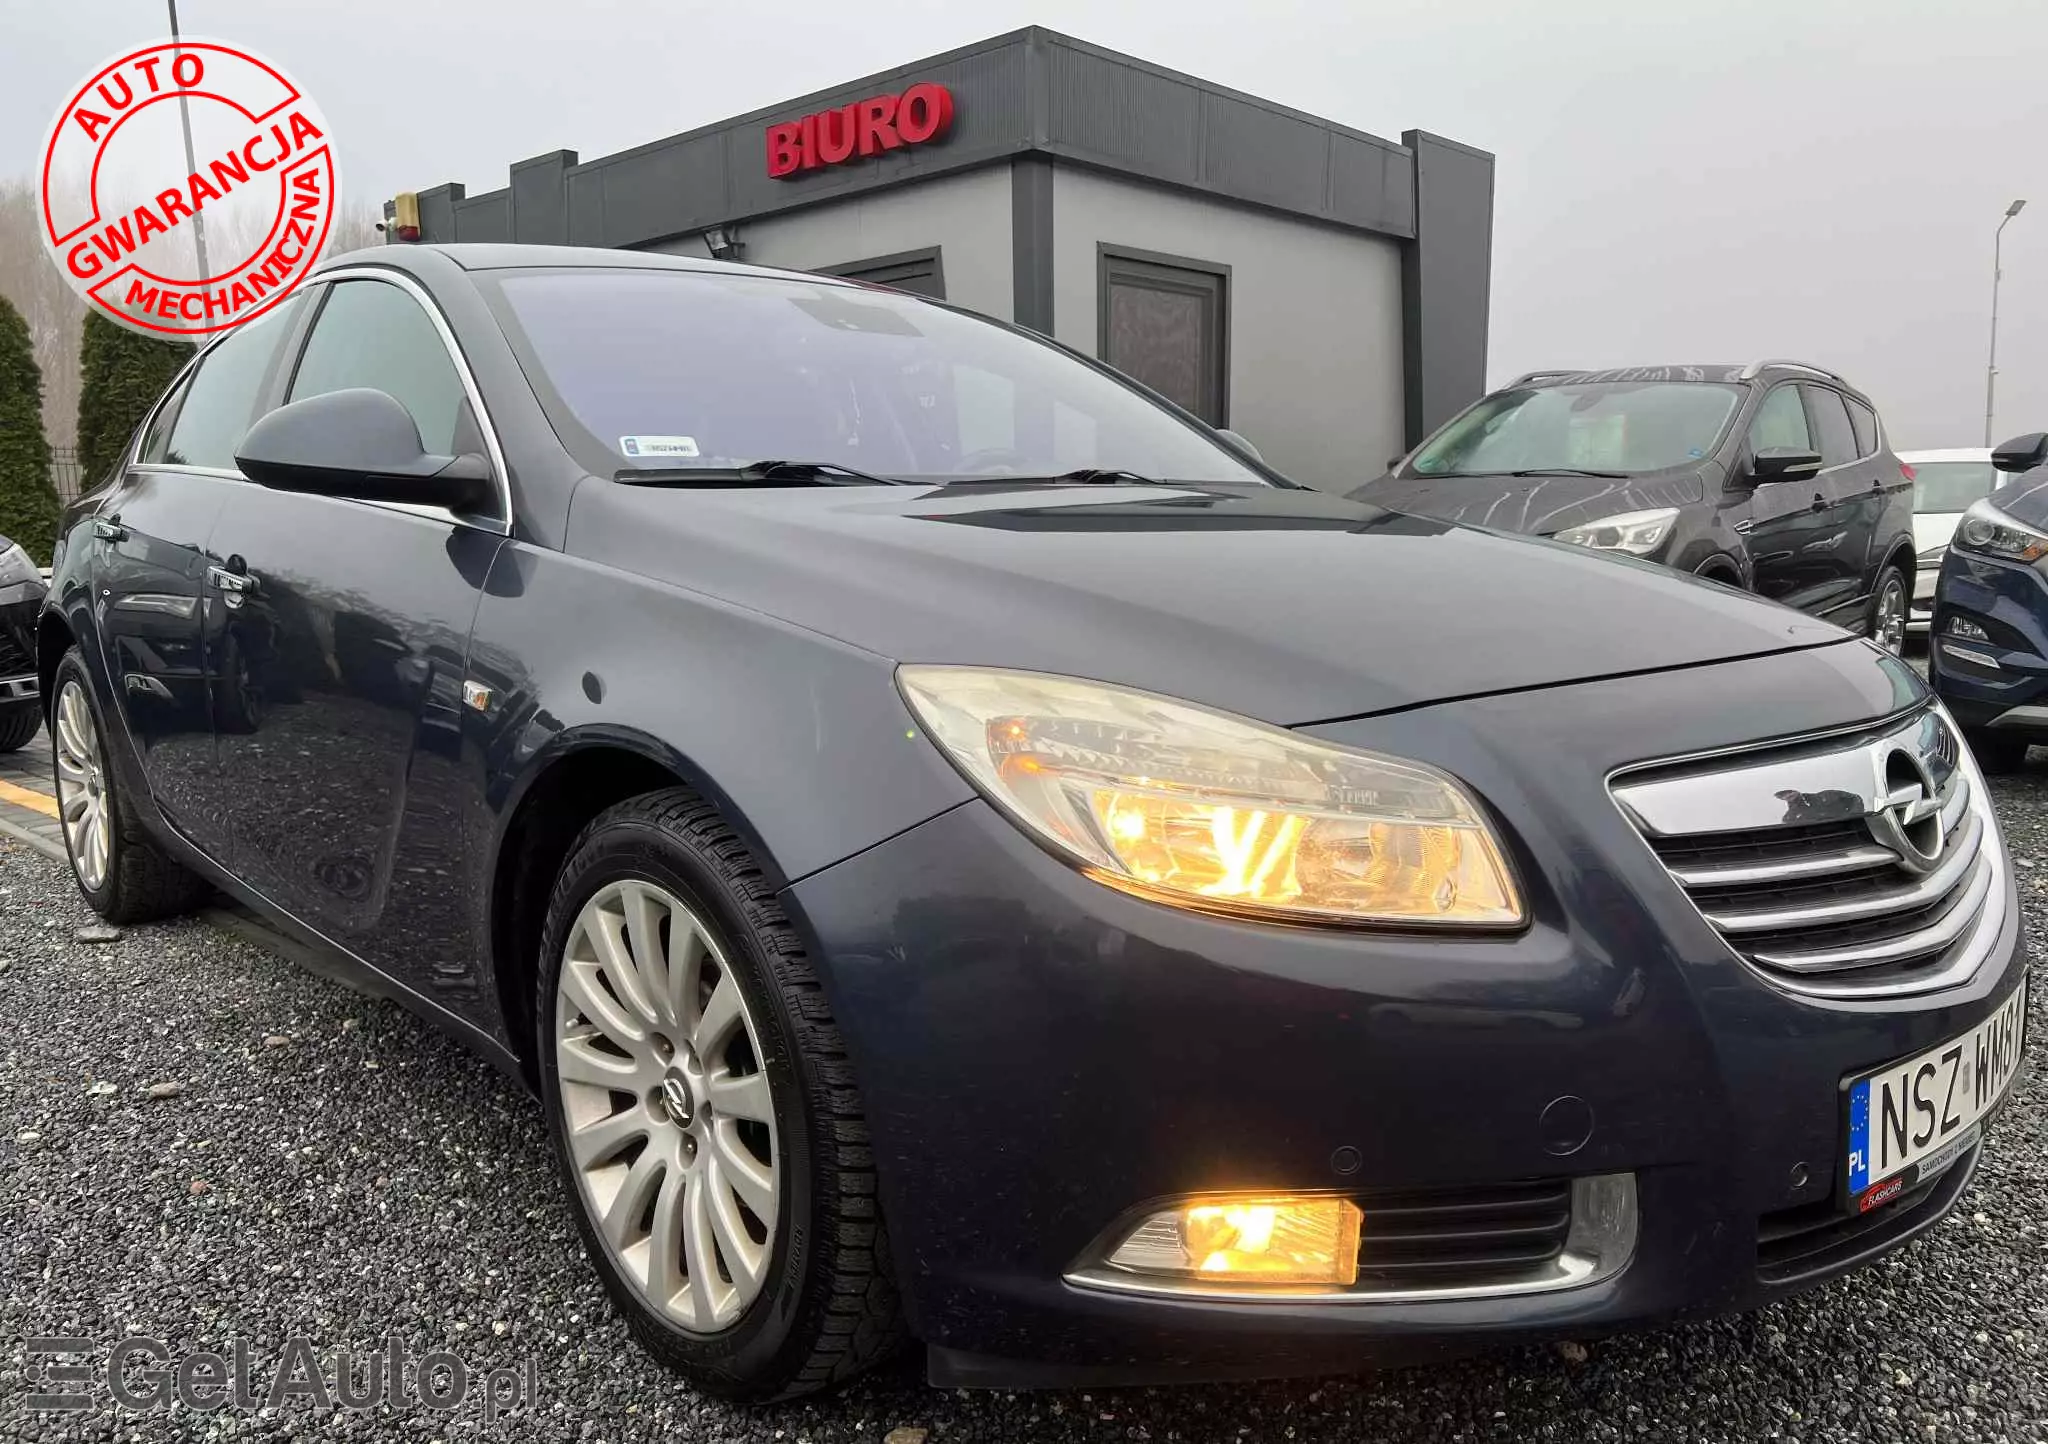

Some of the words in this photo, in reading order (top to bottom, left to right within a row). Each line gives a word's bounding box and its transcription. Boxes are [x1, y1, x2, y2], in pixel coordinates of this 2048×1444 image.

[765, 82, 954, 179] BIURO
[1881, 1043, 1963, 1170] NSZ
[1848, 1149, 1866, 1177] PL
